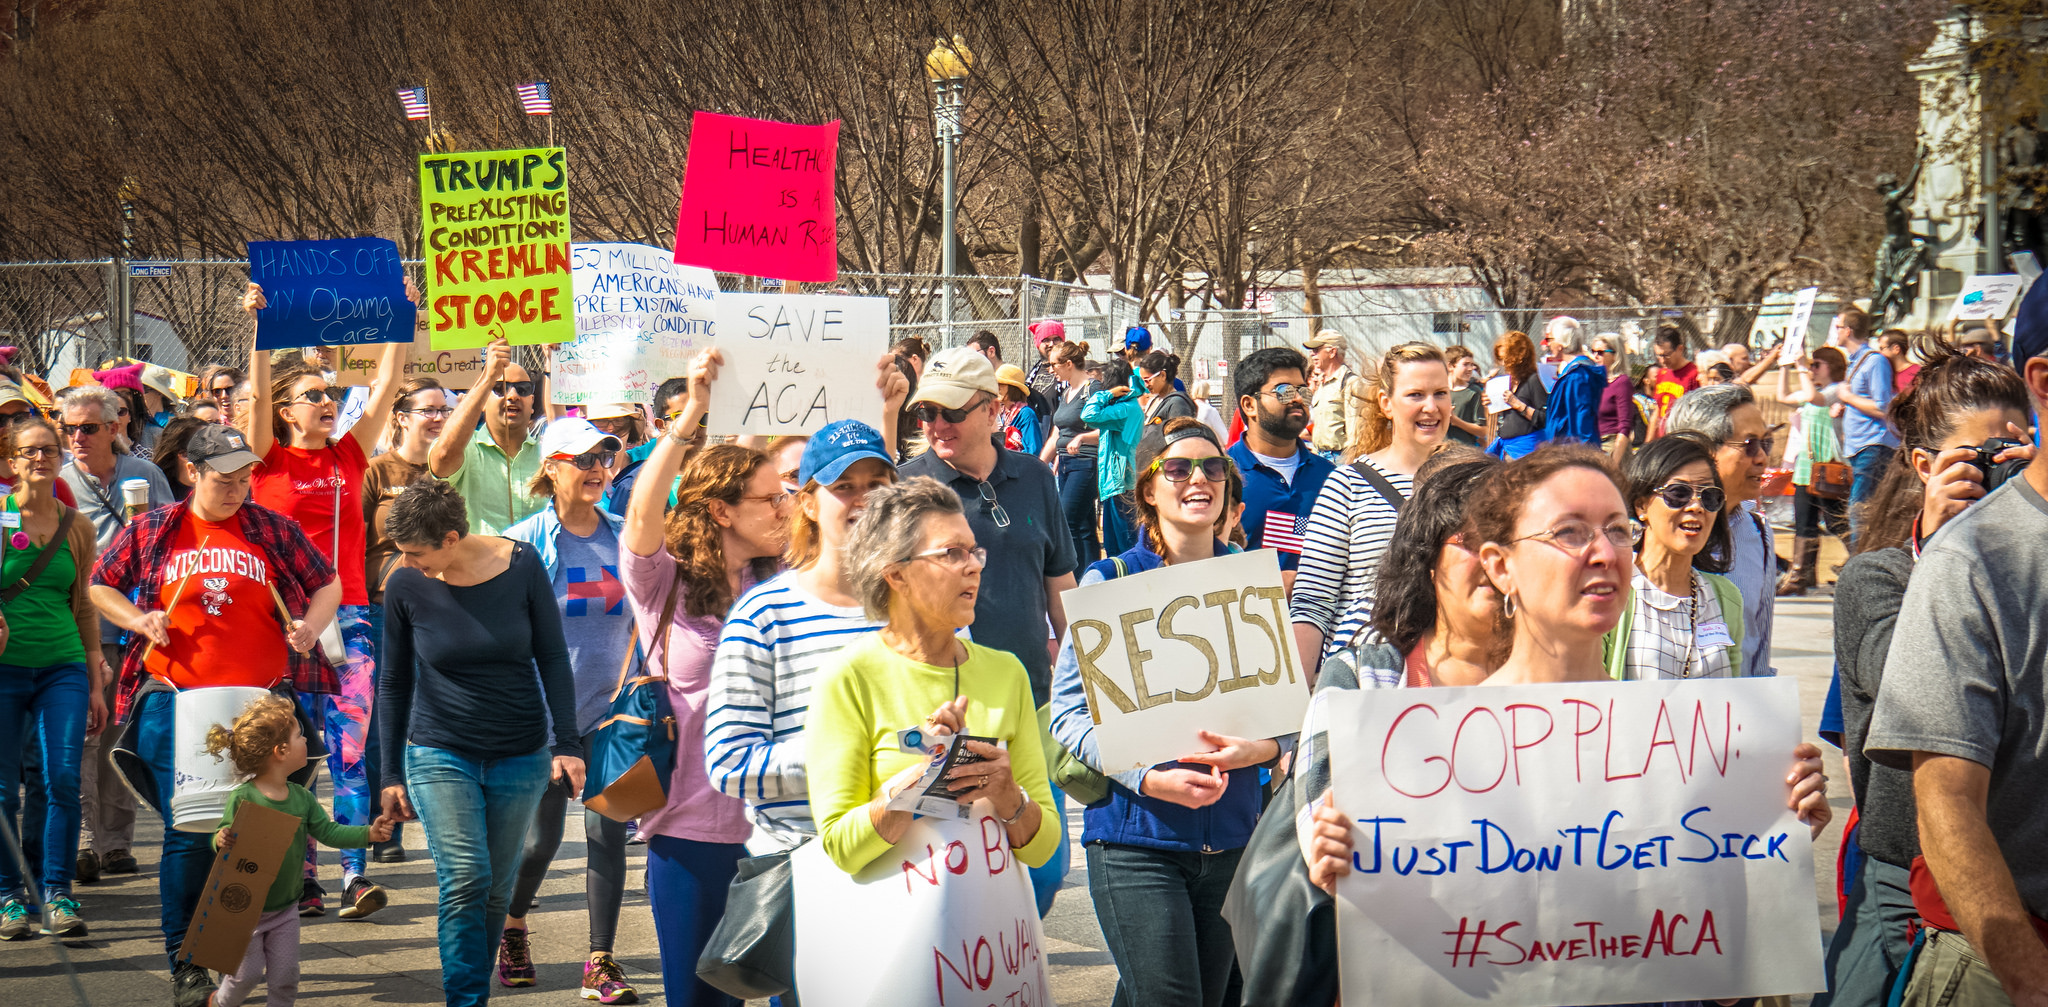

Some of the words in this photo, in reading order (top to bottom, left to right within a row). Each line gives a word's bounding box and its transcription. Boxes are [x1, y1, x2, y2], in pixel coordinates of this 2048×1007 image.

[424, 150, 566, 193] TRUMP'S
[429, 191, 567, 224] PREEXISTING
[778, 189, 798, 208] IS
[812, 189, 821, 212] A
[429, 220, 565, 252] CONDITION:
[704, 210, 788, 247] HUMAN
[798, 220, 835, 257] RIG
[131, 266, 149, 276] LONG
[149, 266, 170, 276] FENCE
[259, 247, 347, 279] HANDS
[354, 246, 397, 276] OFF
[435, 242, 572, 287] KREMLIN
[572, 247, 601, 270] 52
[608, 249, 680, 276] MILLION
[591, 272, 686, 296] AMERICANS
[260, 288, 295, 322] MY
[308, 287, 395, 322] Obama
[434, 287, 562, 332] STOOGE
[574, 294, 689, 314] PRE-EXISTING
[320, 316, 393, 343] Care!
[747, 305, 843, 342] SAVE
[340, 345, 377, 377] Keeps
[403, 358, 437, 374] erica
[436, 352, 482, 375] Great
[766, 354, 806, 374] the
[742, 381, 829, 427] ACA
[165, 548, 266, 587] WISCONSIN
[1069, 585, 1296, 726] RESIST
[1381, 702, 1554, 799] GOP
[1562, 698, 1742, 785] PLAN:
[901, 840, 969, 896] NO
[933, 934, 995, 1007] NO
